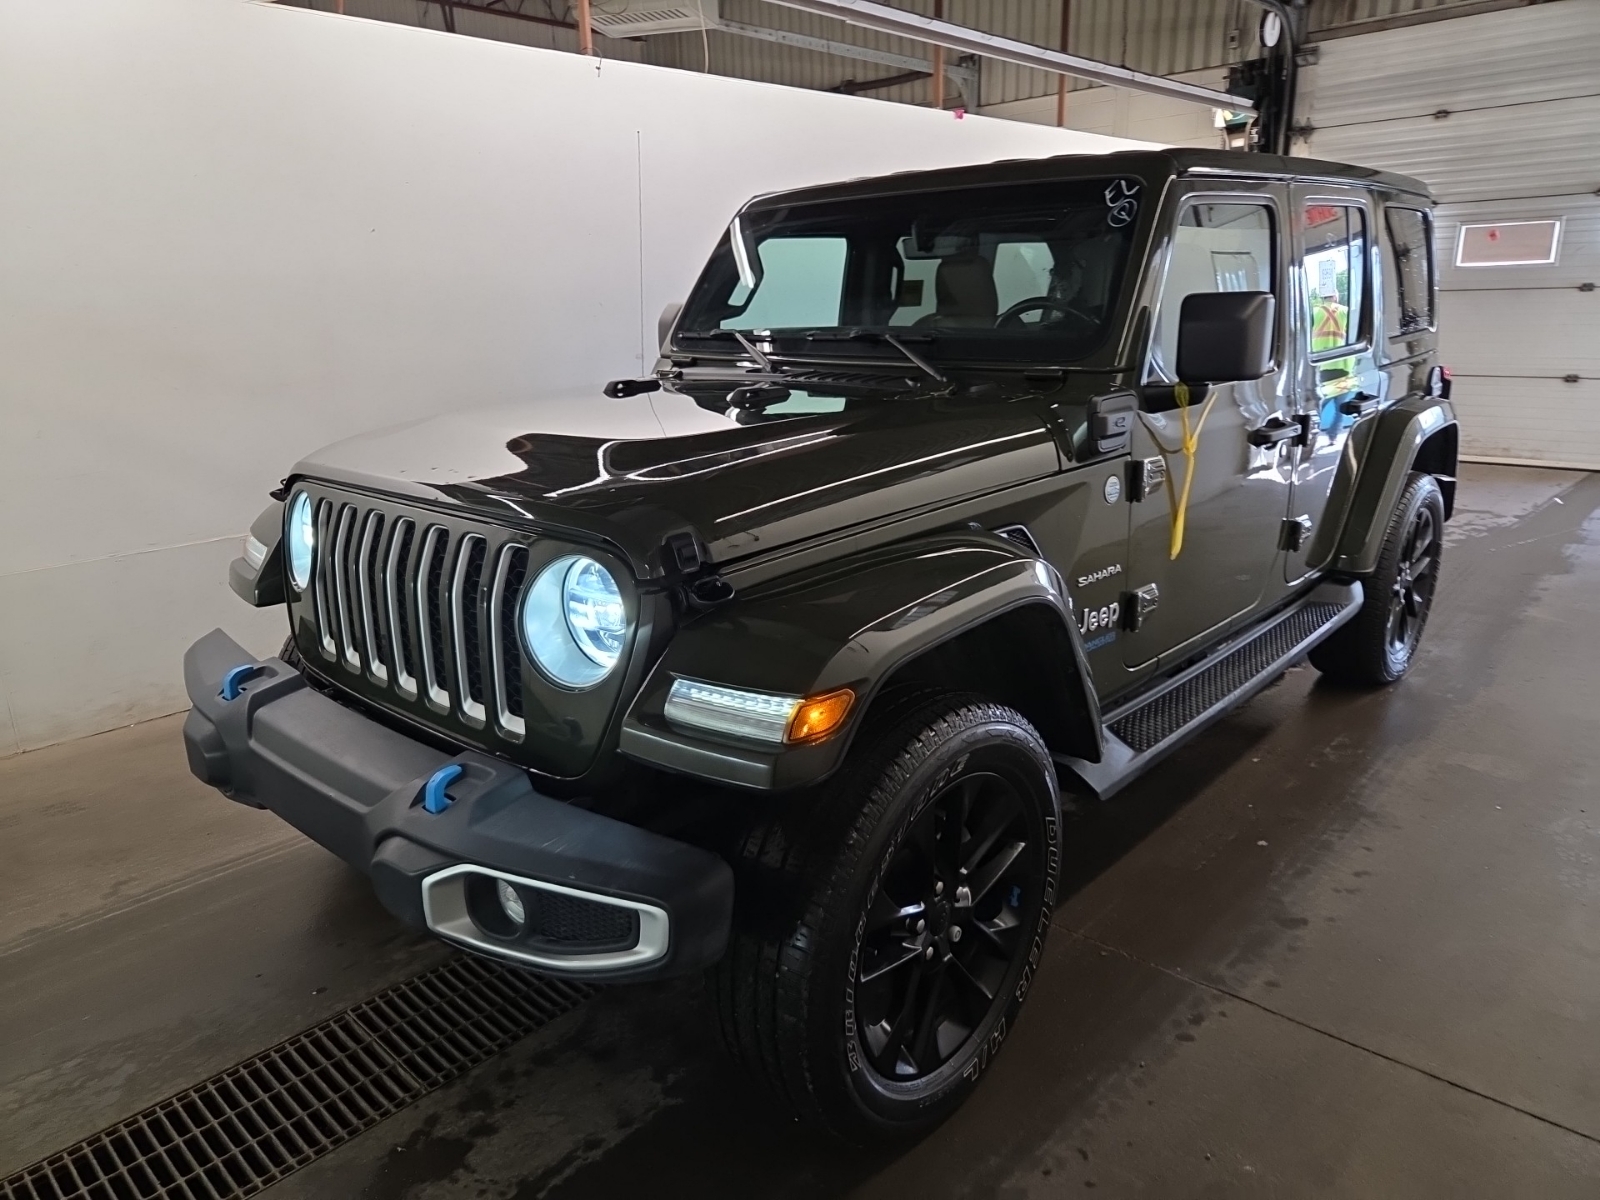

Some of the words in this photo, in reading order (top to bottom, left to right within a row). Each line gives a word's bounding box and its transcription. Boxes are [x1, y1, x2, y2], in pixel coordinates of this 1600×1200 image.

[1077, 563, 1122, 588] SAHARA
[1078, 602, 1120, 635] Jeep
[1015, 816, 1058, 1002] DUELER
[963, 1017, 1007, 1082] H/L
